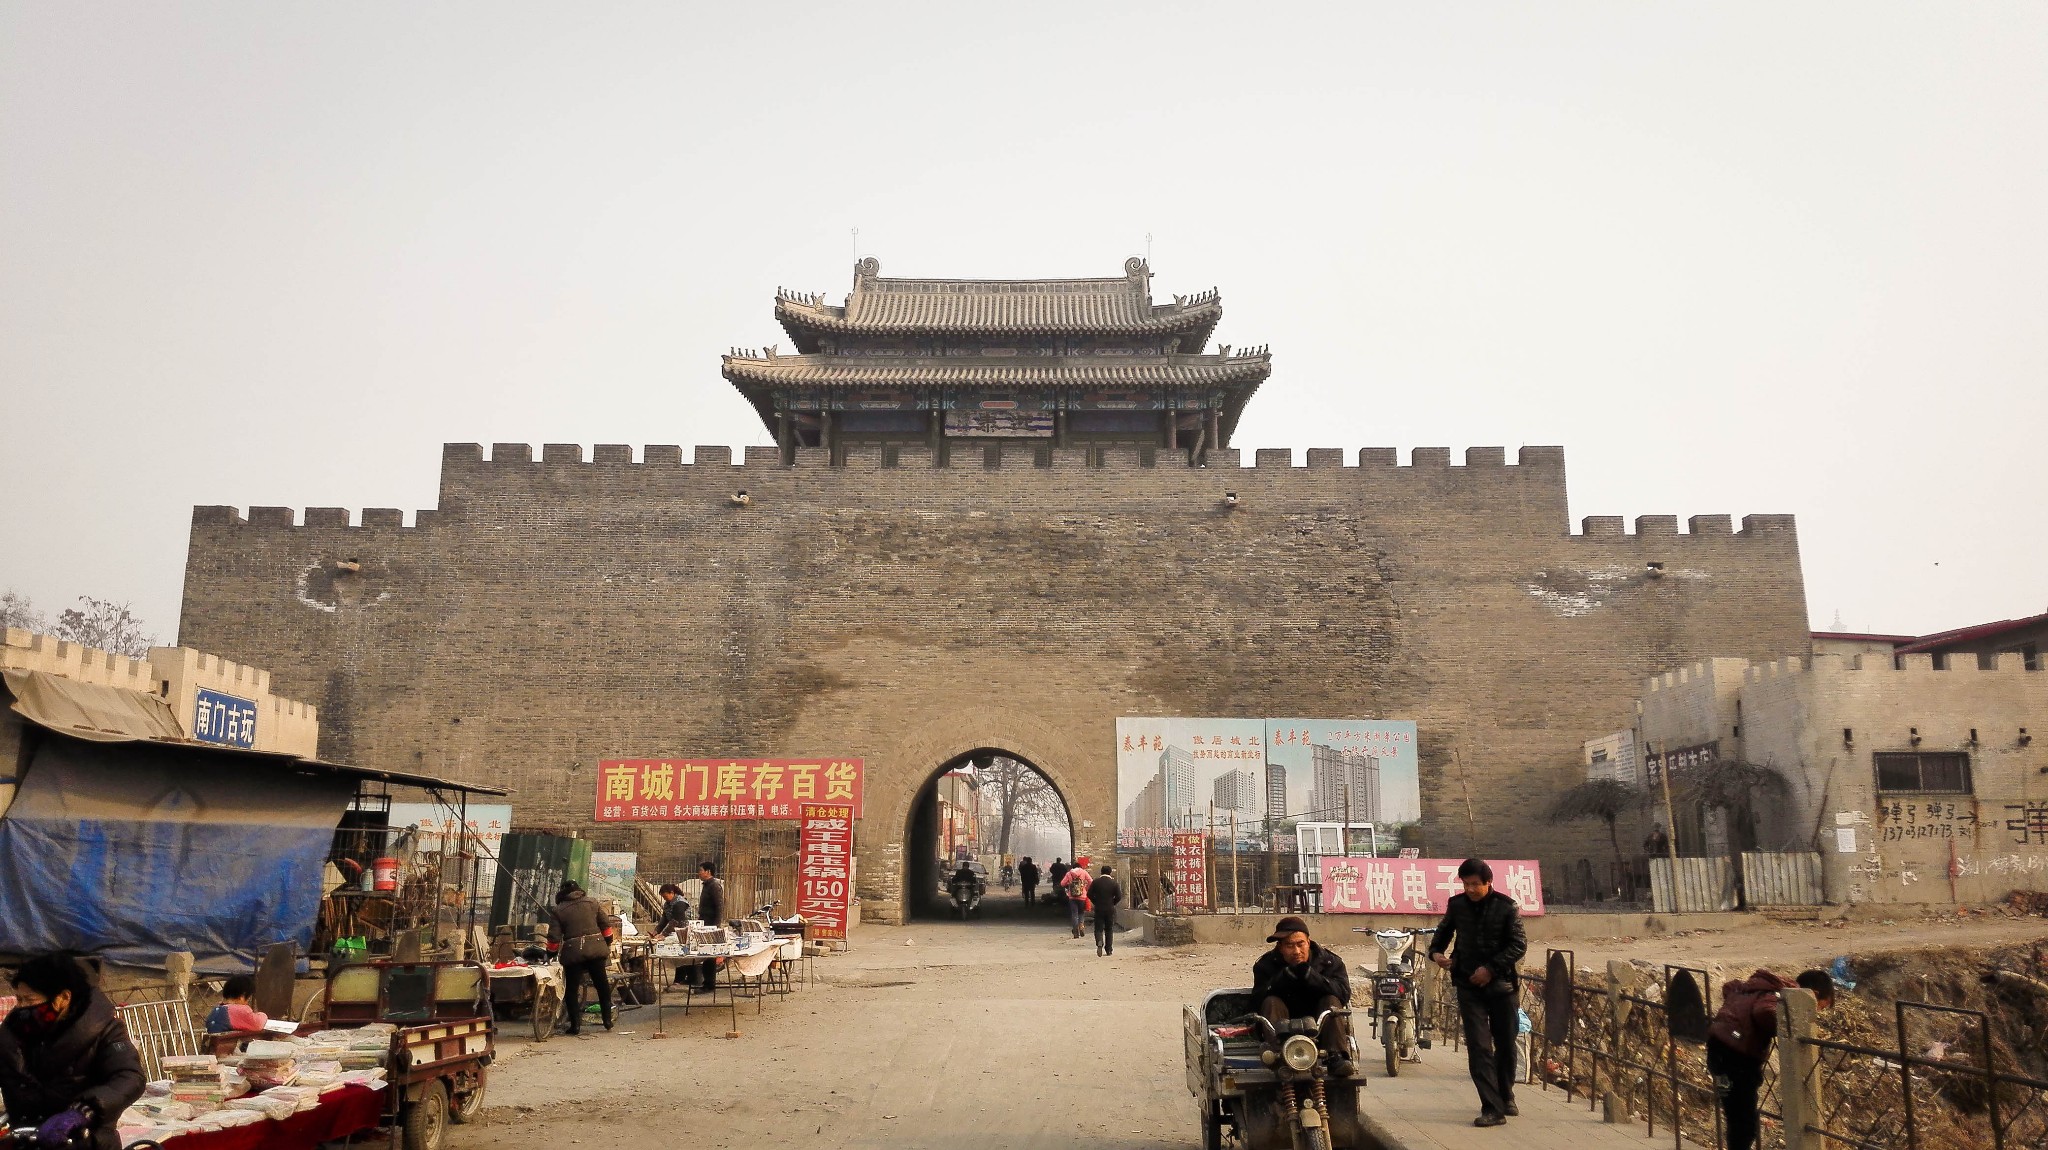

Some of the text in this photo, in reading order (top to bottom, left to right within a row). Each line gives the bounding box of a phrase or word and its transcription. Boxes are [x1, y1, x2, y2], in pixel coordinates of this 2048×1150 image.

[197, 697, 254, 743] 南门古玩
[1123, 734, 1164, 752] 泰丰苑
[1192, 735, 1260, 746] 傲居城北
[1274, 728, 1312, 746] 泰丰苑
[604, 762, 857, 801] 南城门库存百货
[603, 805, 626, 818] 经营：
[631, 804, 668, 817] 百货公司
[805, 806, 849, 818] 清仓处理
[1926, 802, 1955, 820] 弹弓
[1174, 846, 1201, 856] 秋衣
[1174, 858, 1202, 869] 秋裤
[1175, 871, 1202, 882] 背心
[1175, 884, 1203, 895] 保暖
[1330, 861, 1540, 911] 定做电子炮
